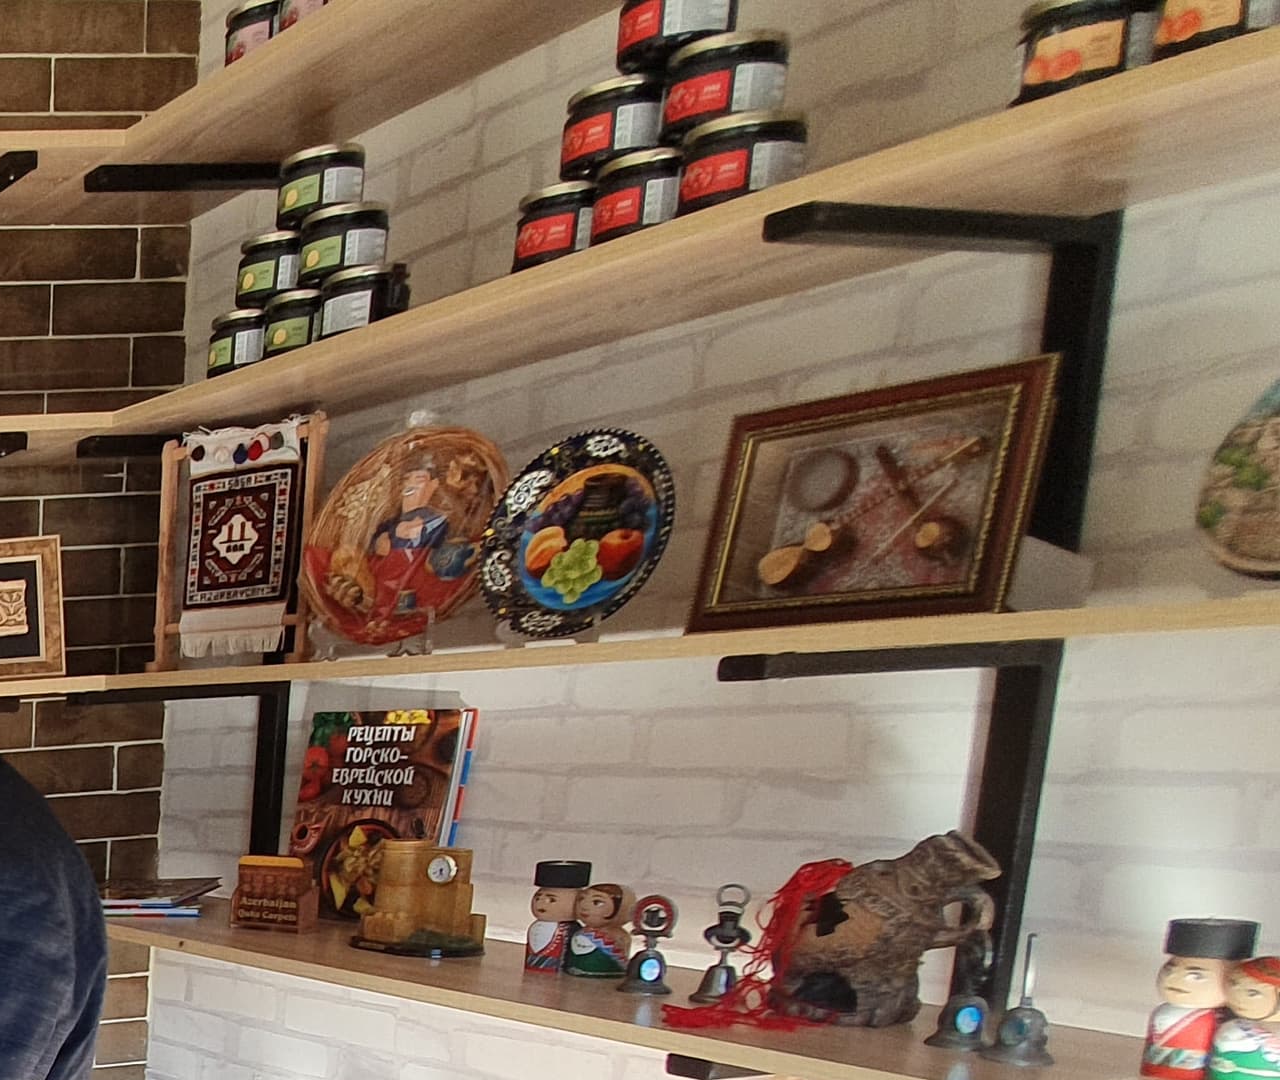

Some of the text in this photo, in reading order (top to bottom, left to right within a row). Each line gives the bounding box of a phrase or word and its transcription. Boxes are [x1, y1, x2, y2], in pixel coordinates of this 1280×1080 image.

[347, 725, 417, 746] РЕЦЕПТЫ
[345, 747, 409, 766] ГОРСКО-
[332, 766, 416, 785] ЕВРЕЙСКОЙ
[342, 788, 394, 806] КУХНИ
